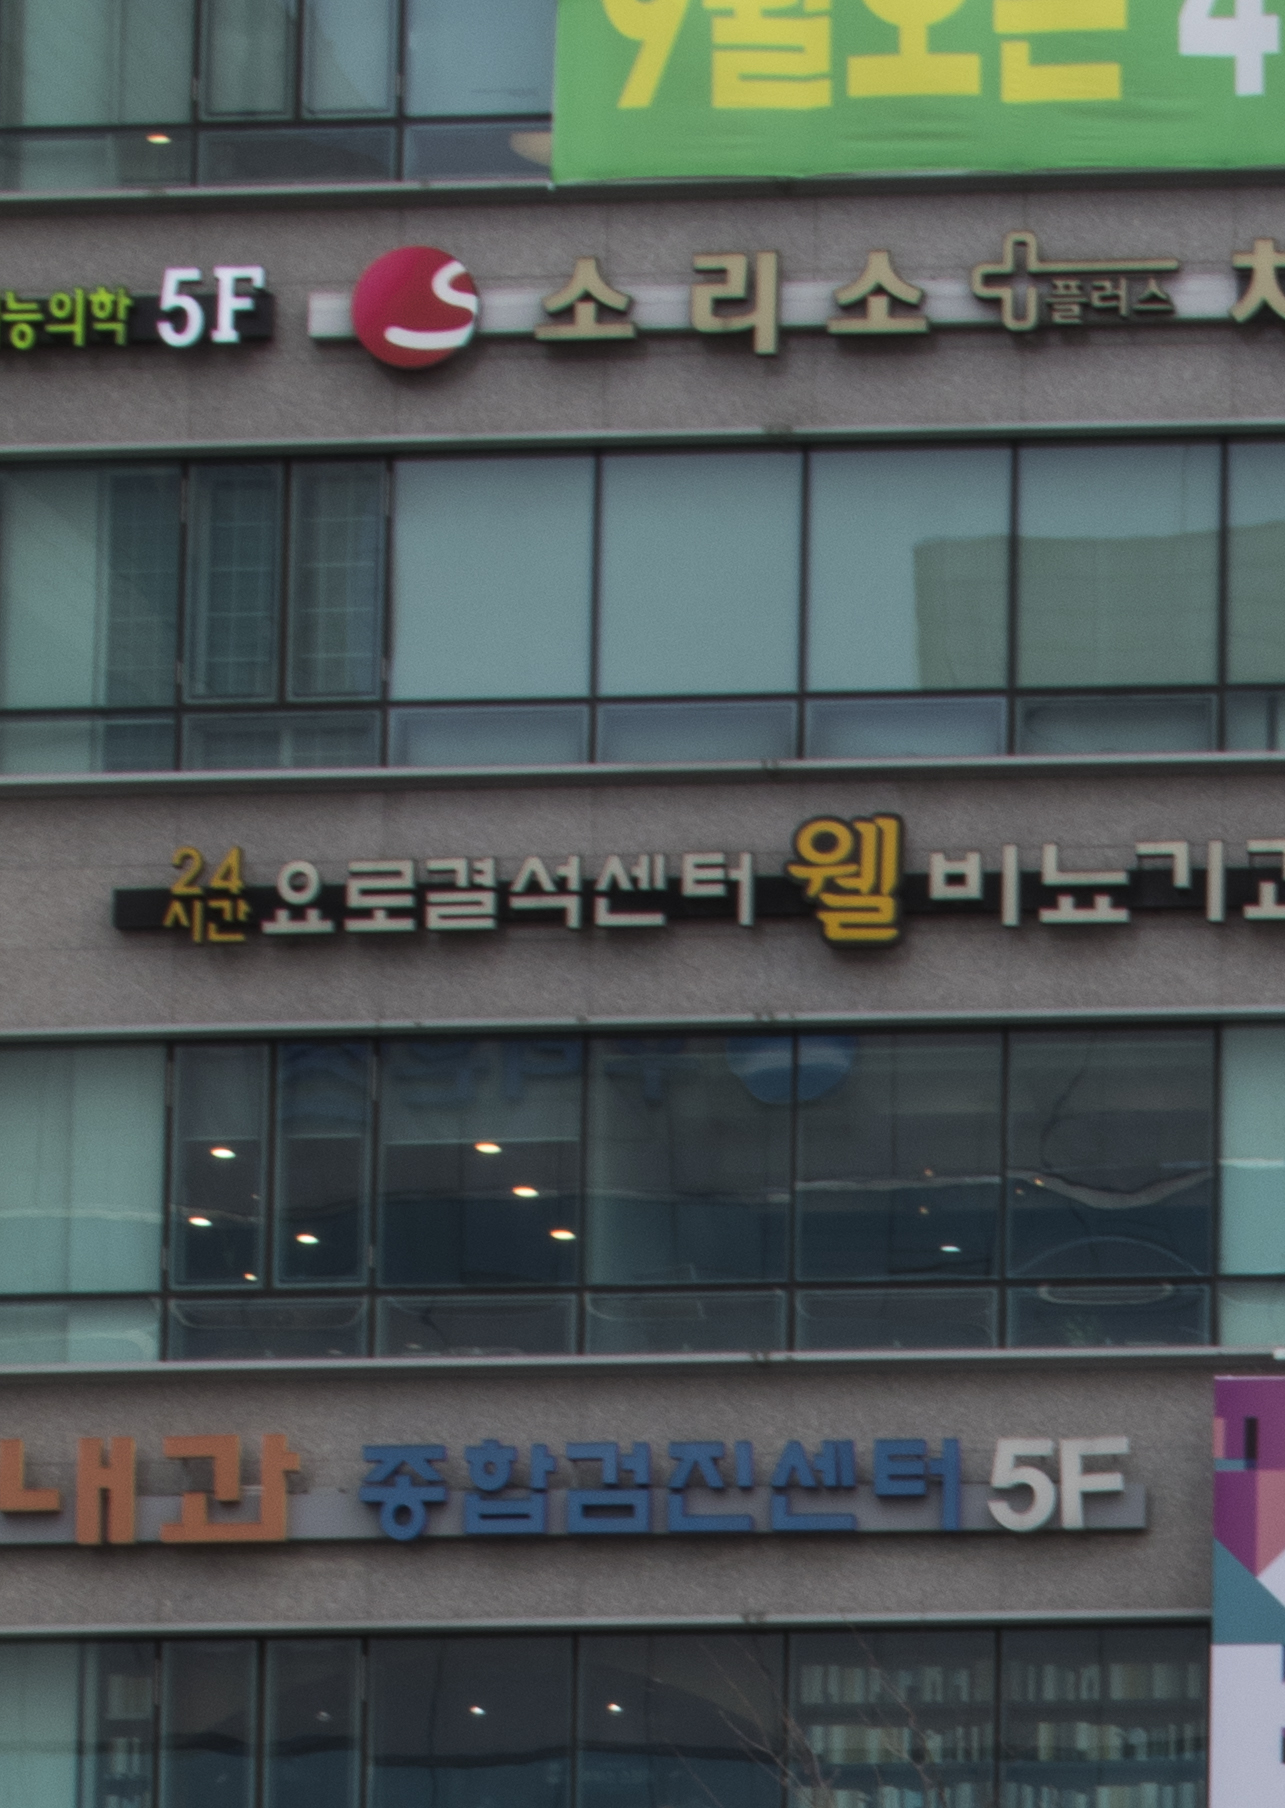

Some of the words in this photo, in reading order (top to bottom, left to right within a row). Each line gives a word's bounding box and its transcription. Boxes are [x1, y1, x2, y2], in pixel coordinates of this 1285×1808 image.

[157, 266, 266, 346] 5F
[1045, 277, 1177, 324] 플러스
[172, 848, 243, 894] 24
[262, 853, 755, 934] 요로결석센터
[163, 899, 251, 943] 시간
[359, 1438, 962, 1541] 종합검진센터
[988, 1436, 1130, 1532] 5F
